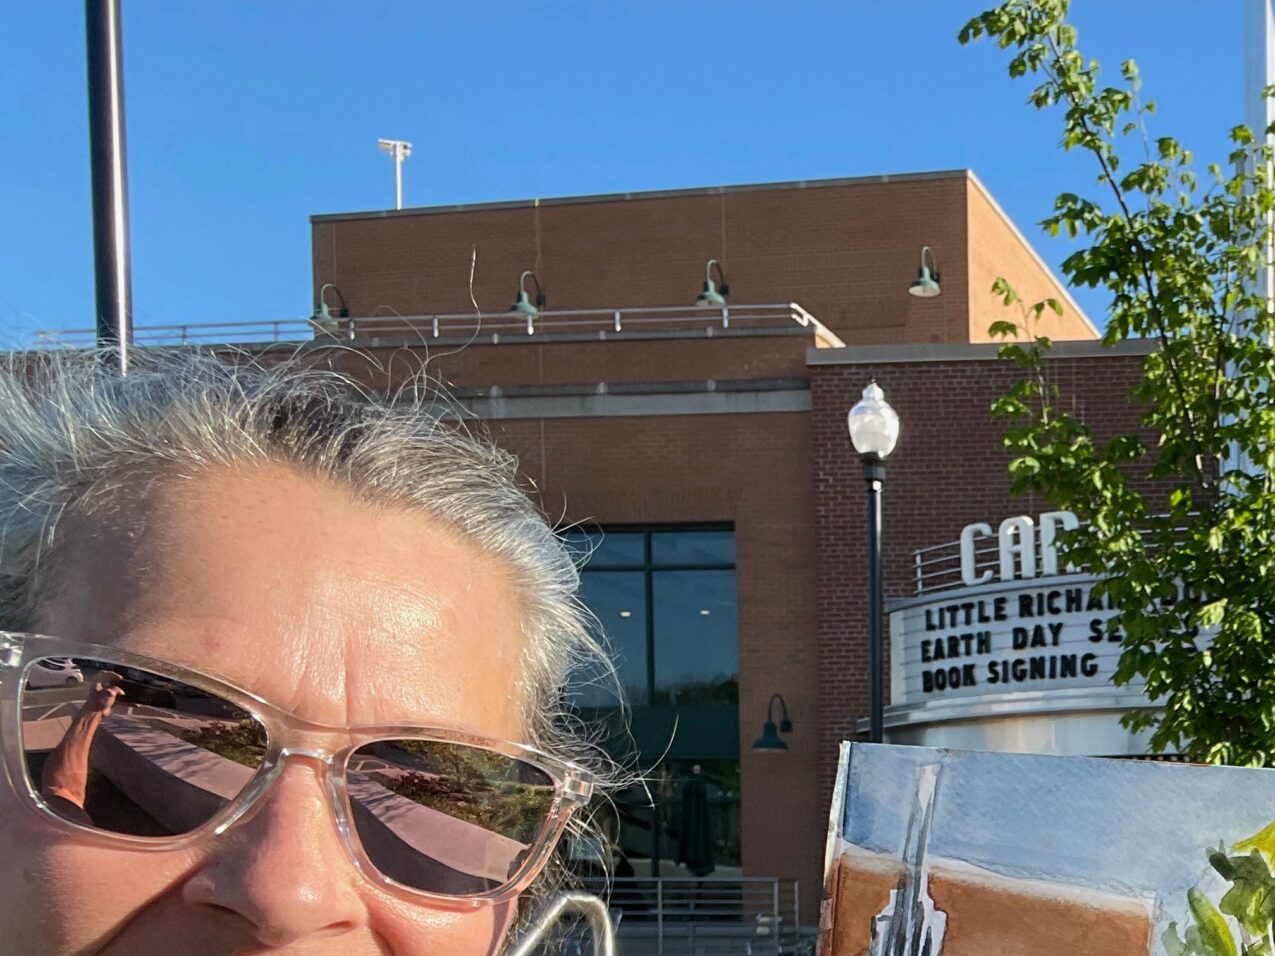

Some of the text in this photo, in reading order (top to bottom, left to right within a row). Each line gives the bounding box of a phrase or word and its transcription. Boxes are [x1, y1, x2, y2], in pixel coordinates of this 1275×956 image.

[960, 511, 1080, 587] CAR
[925, 597, 1008, 631] LITTLE
[921, 630, 992, 662] EARTH
[1012, 622, 1064, 650] DAY
[922, 652, 1098, 692] BOOK SIGNING
